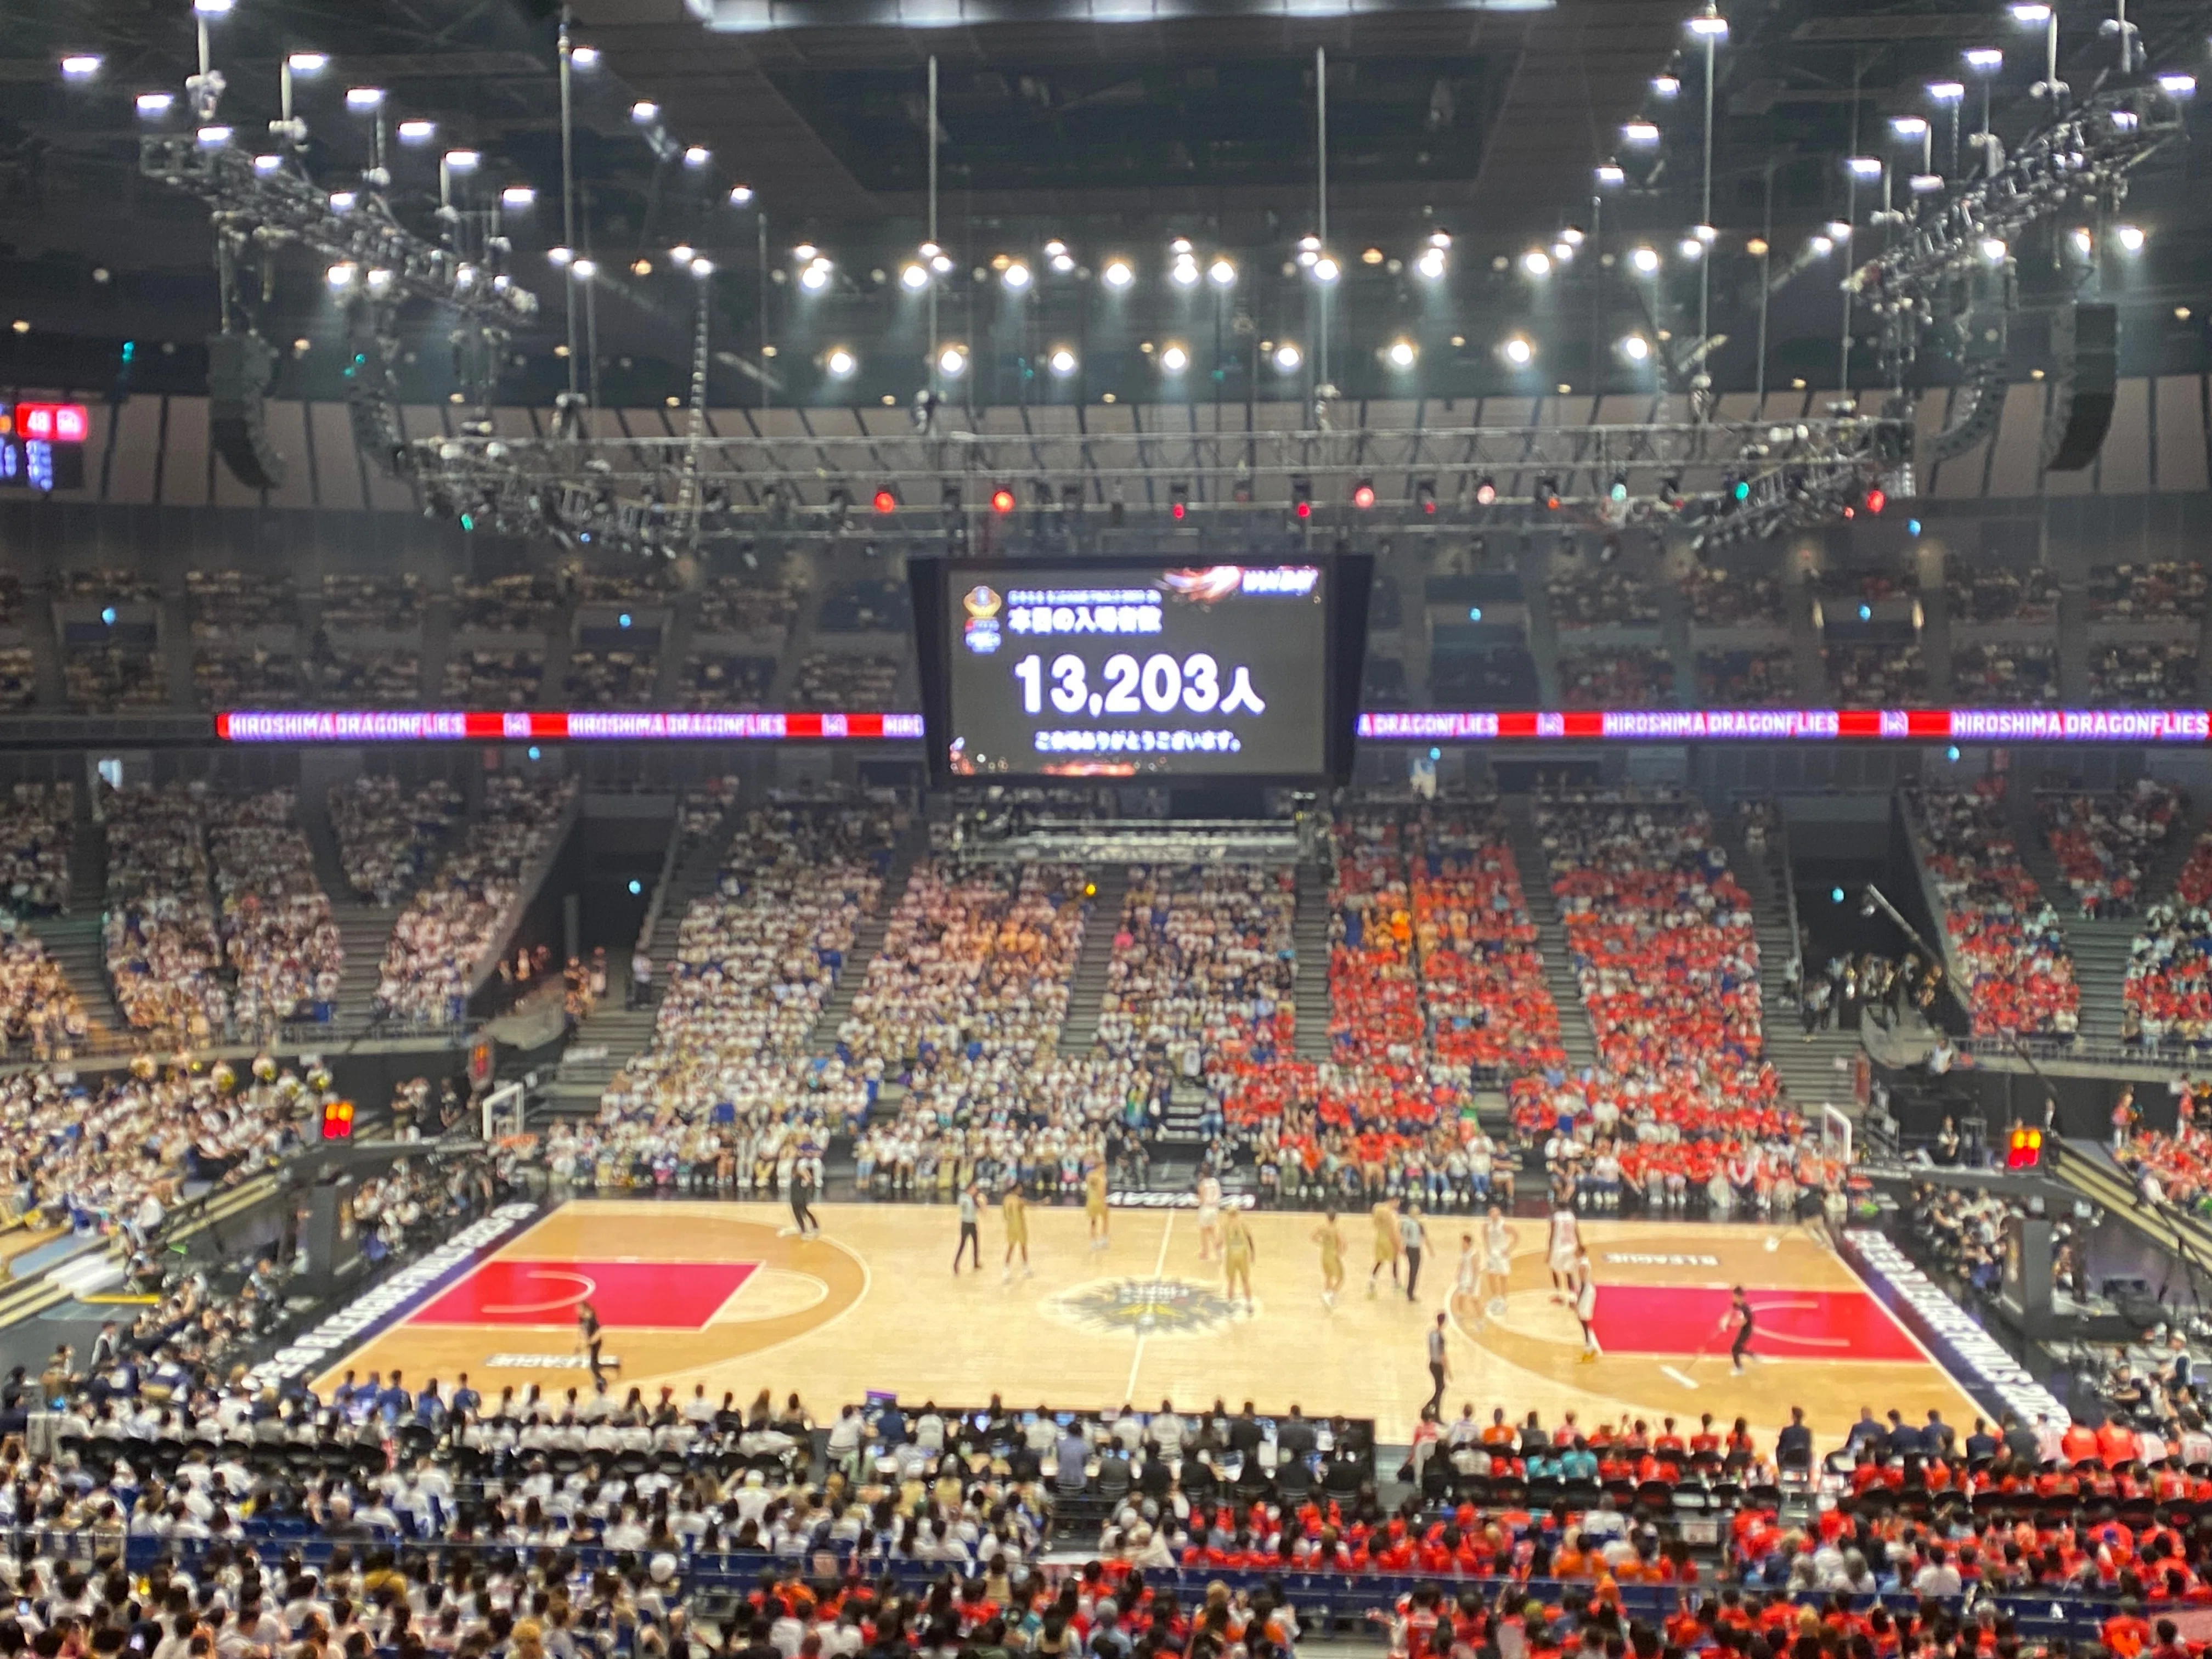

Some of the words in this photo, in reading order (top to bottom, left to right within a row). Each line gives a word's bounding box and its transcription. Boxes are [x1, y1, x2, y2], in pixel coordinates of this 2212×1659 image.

[1014, 653, 1265, 718] 13,203人
[229, 716, 332, 735] HIROSHIMA
[336, 716, 464, 735] DRAGONFLIES
[1374, 715, 1498, 733] DRAGONFLIES
[1605, 715, 1705, 733] HIROSHIMA
[1708, 715, 1838, 733] DRAGONFLIES
[1952, 714, 2062, 733] HIROSHIMA
[2065, 714, 2209, 733] DRAGONFLIES
